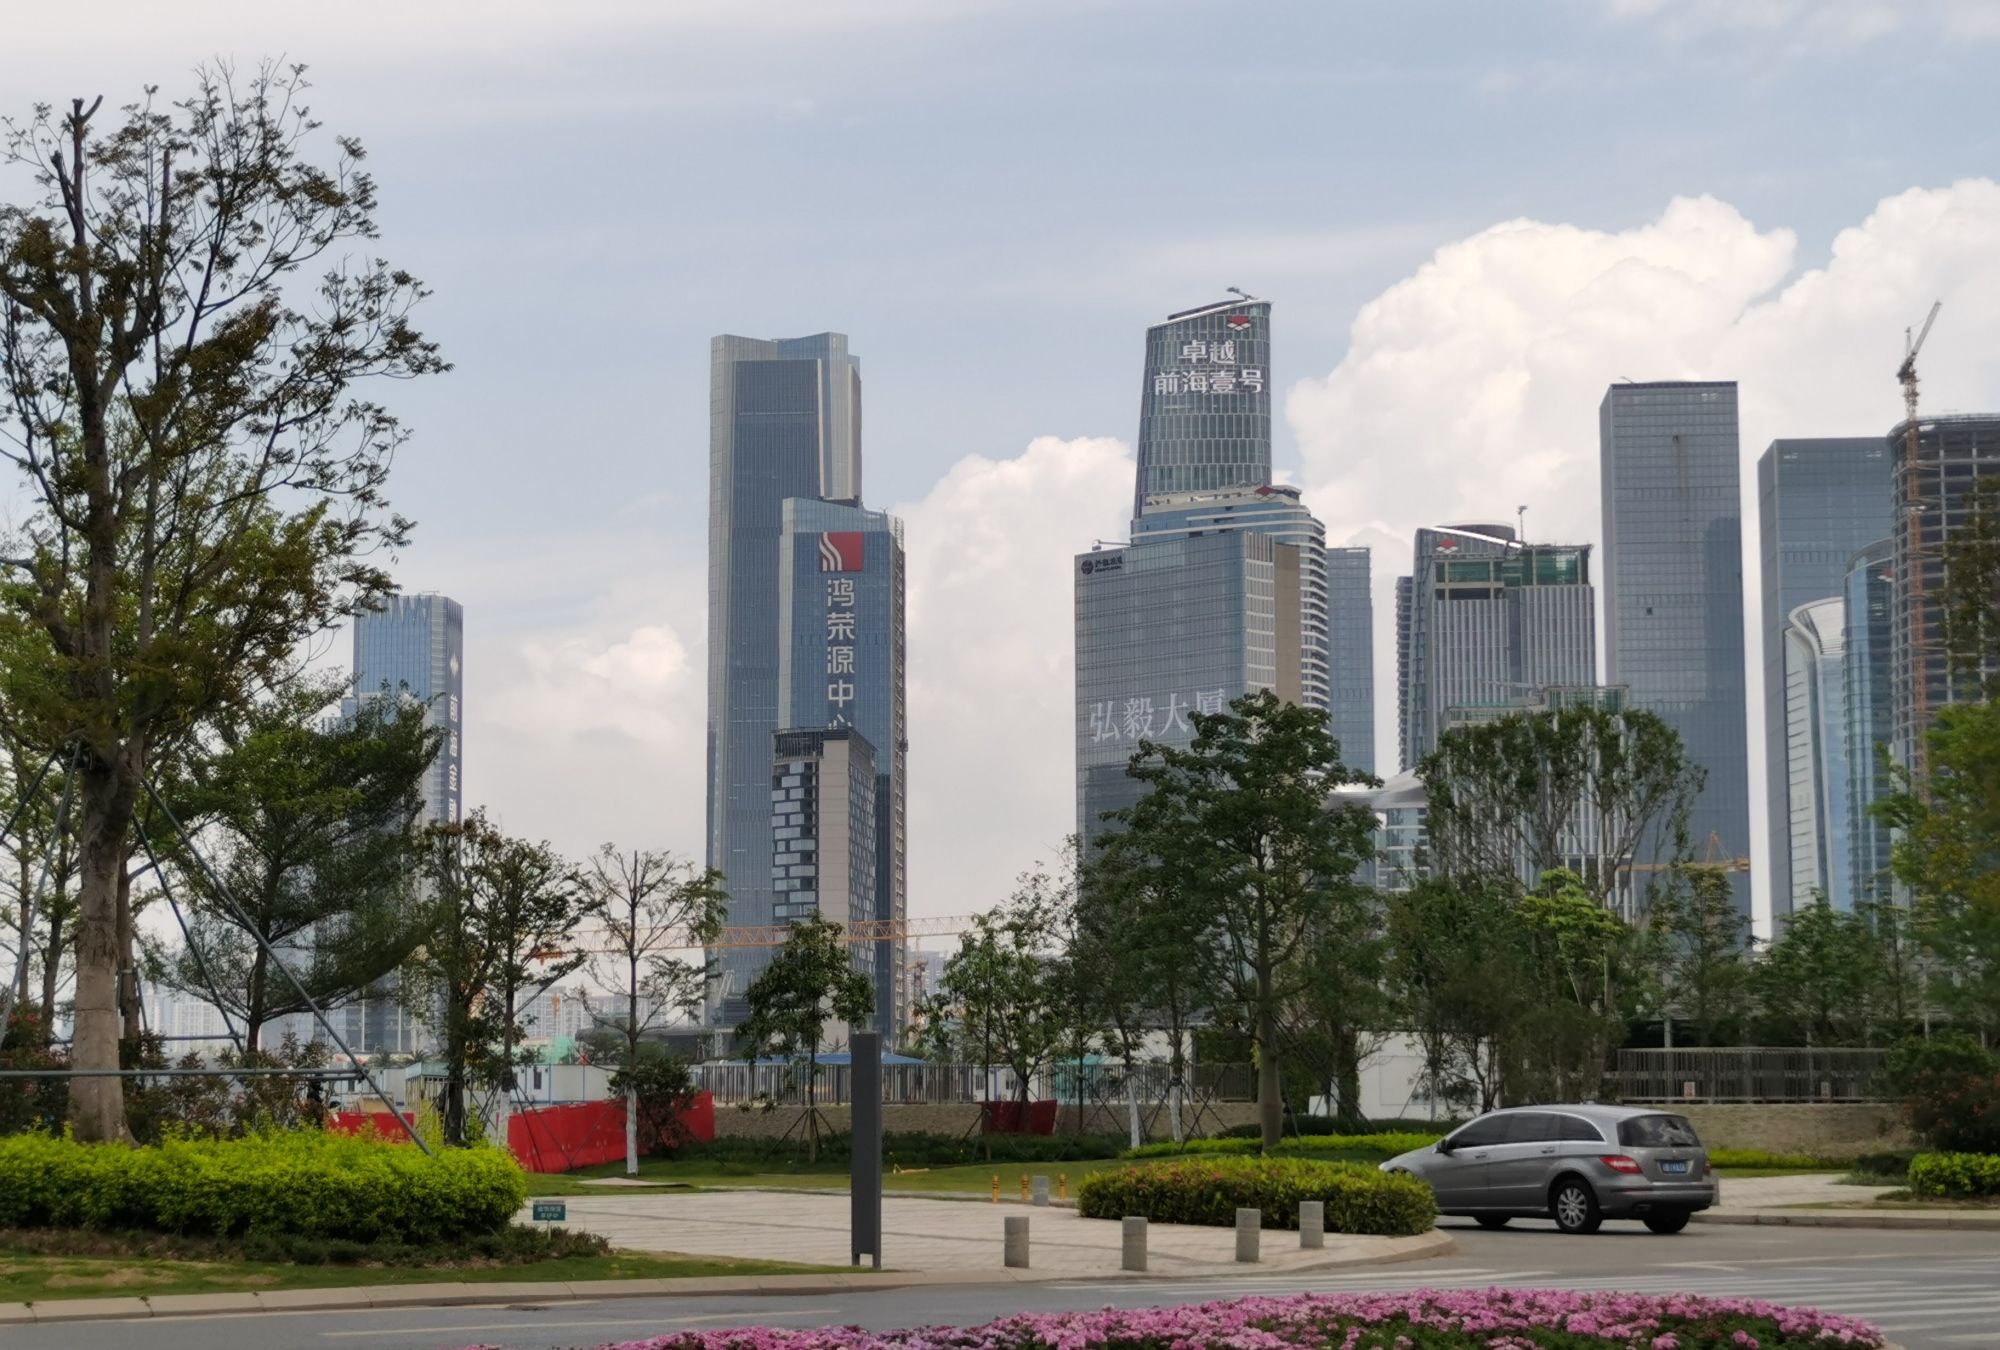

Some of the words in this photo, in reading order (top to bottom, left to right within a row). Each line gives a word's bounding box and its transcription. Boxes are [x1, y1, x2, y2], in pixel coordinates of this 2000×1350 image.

[1177, 340, 1235, 364] 卓越
[1154, 369, 1263, 395] 前海壹号
